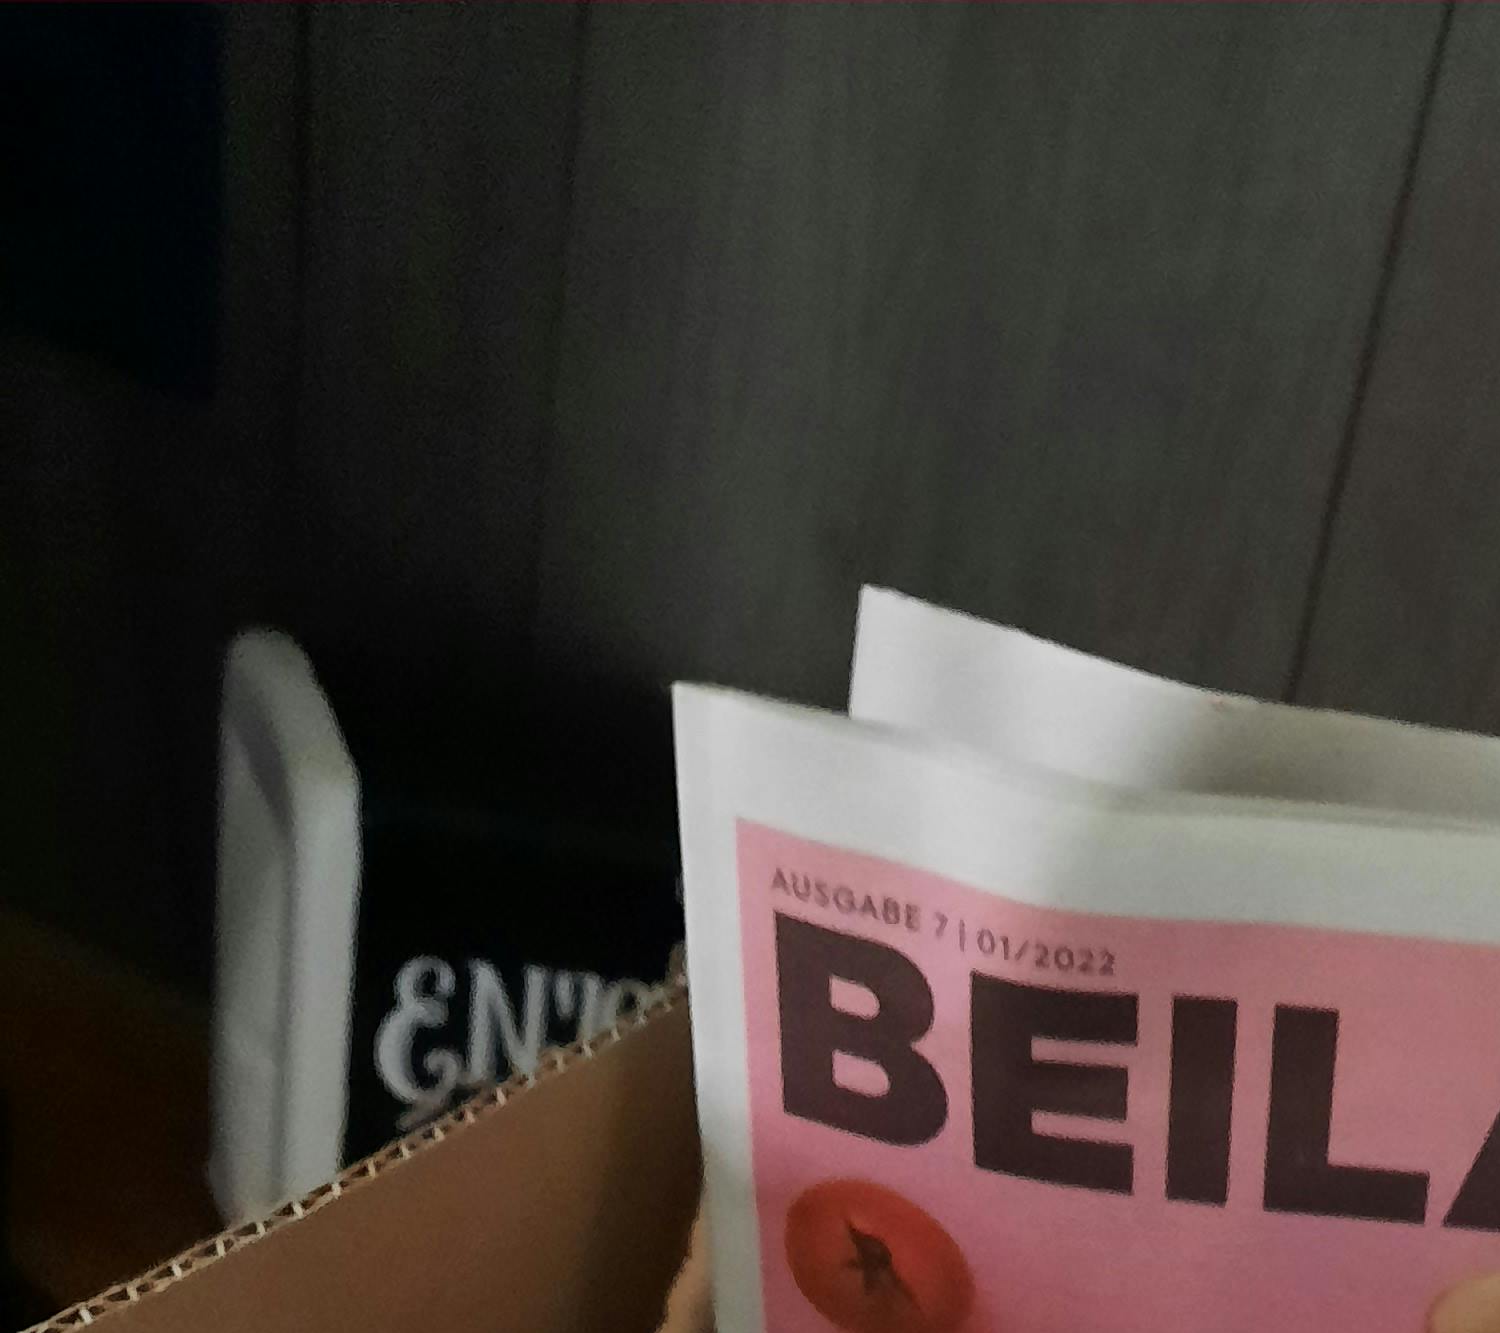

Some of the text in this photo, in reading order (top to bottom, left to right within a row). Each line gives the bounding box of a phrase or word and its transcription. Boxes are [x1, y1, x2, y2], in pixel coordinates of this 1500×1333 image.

[771, 866, 922, 933] AUSGABE
[934, 911, 949, 938] 7
[976, 927, 1116, 977] 01/2022
